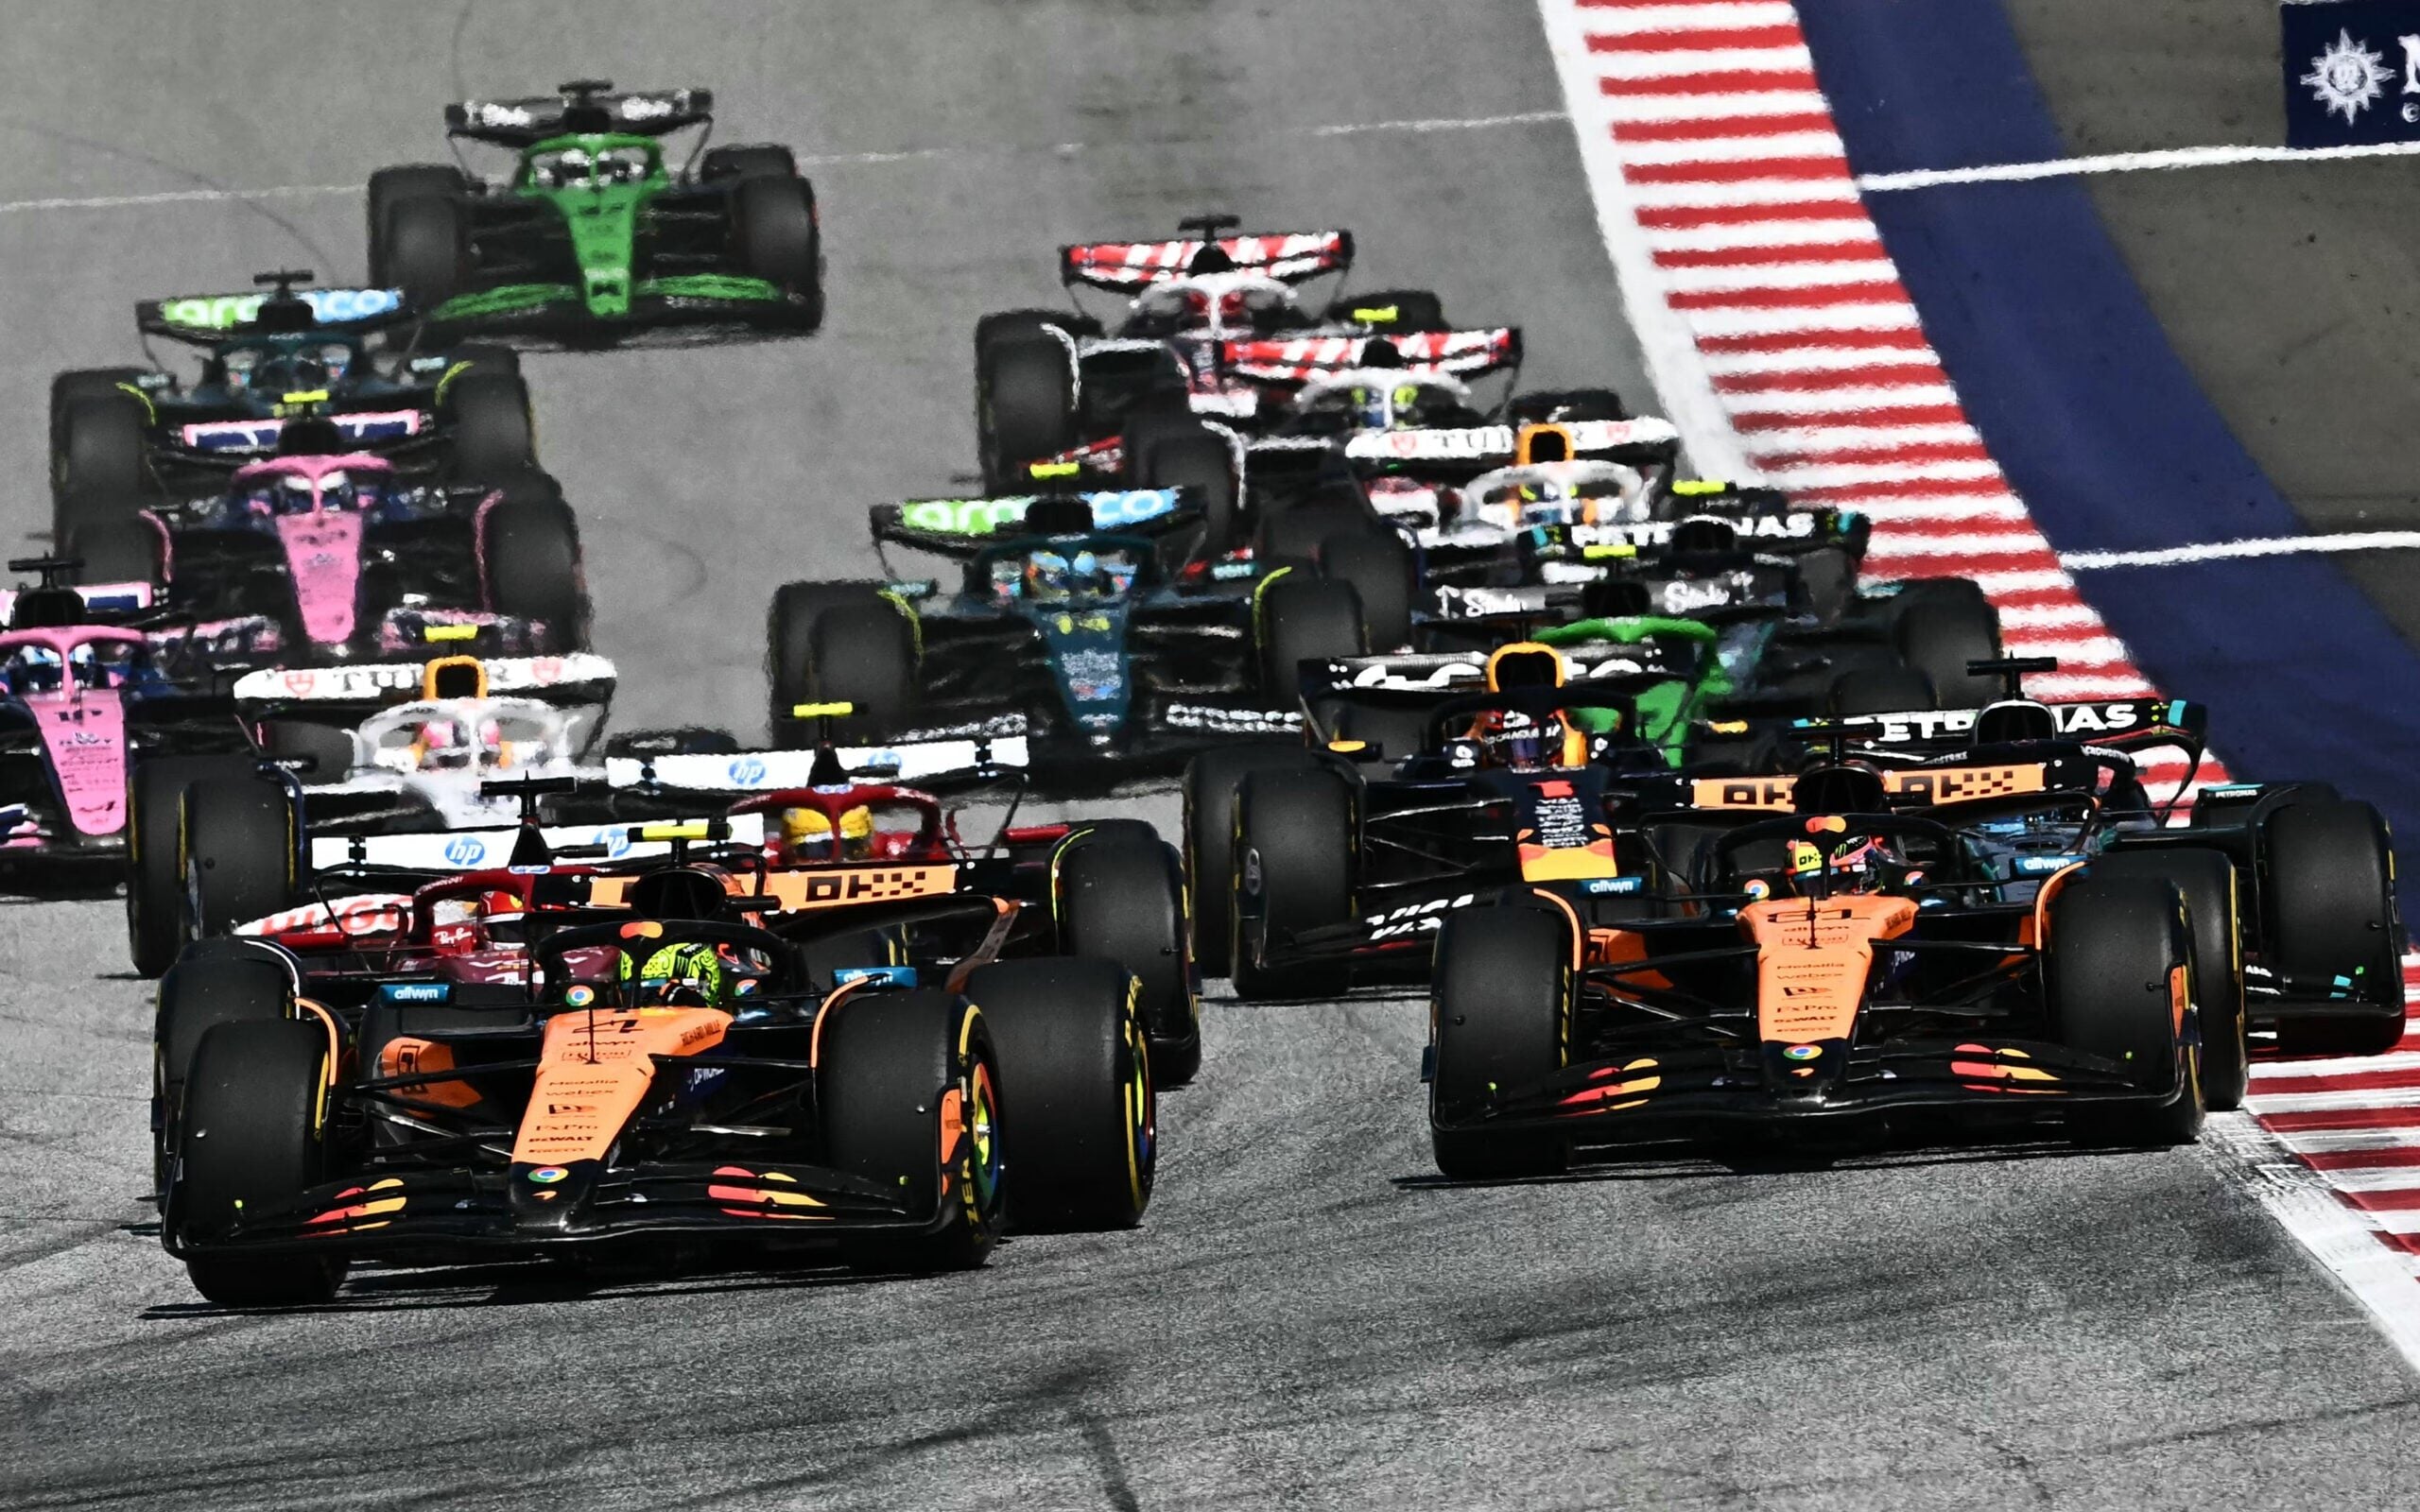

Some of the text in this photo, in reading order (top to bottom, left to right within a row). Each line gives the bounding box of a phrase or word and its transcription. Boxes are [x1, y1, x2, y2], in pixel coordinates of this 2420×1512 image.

[448, 836, 482, 866] hp
[1589, 876, 1634, 893] allwyn
[394, 986, 439, 1002] allwyn
